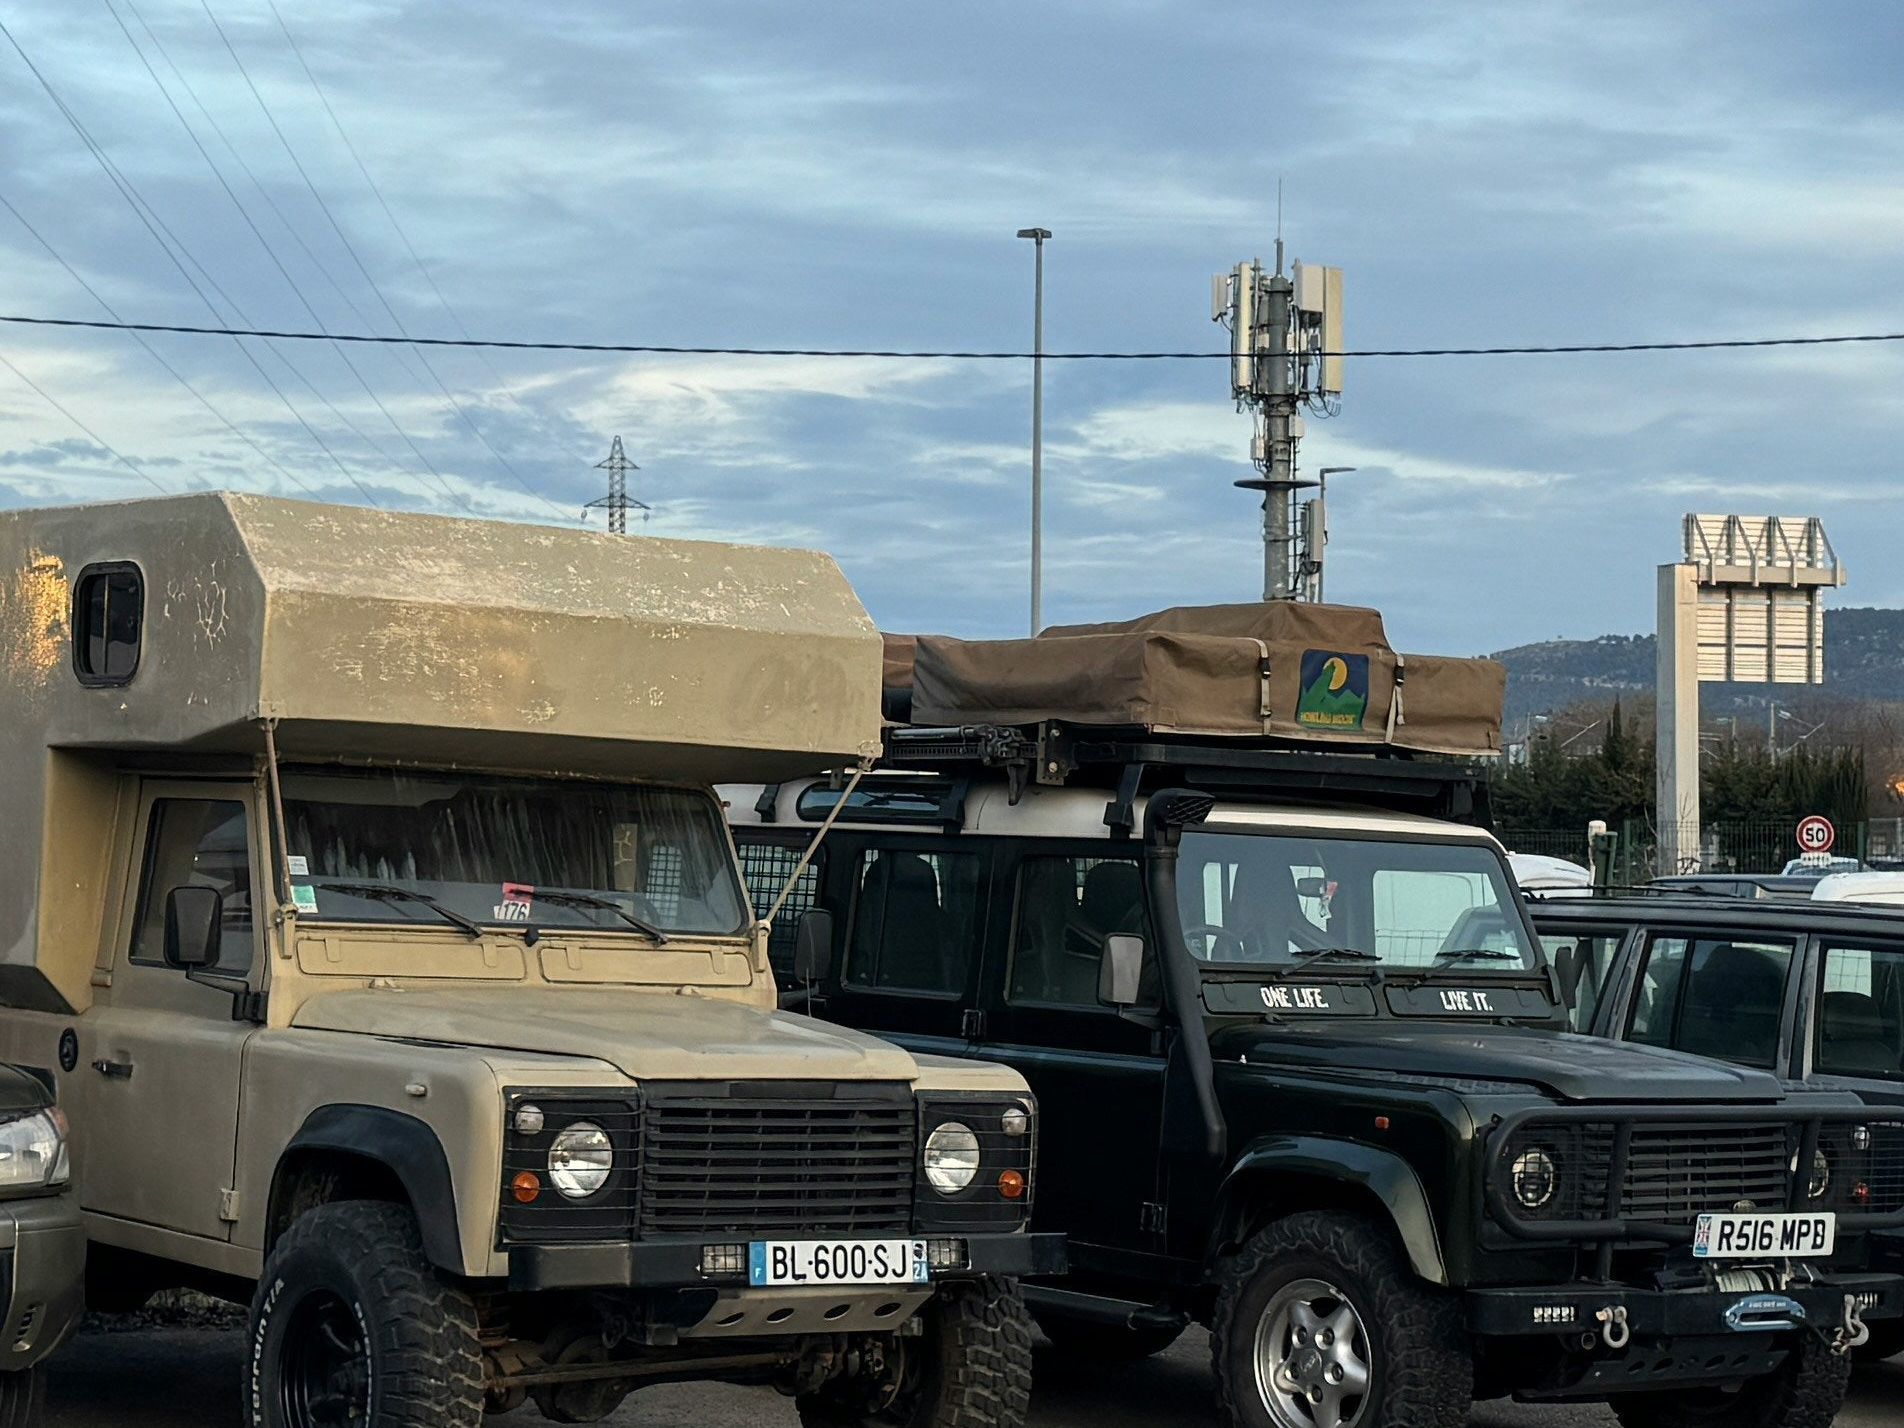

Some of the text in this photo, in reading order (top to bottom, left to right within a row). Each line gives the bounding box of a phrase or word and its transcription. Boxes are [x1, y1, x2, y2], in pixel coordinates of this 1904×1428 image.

[1805, 827, 1825, 842] 50
[1260, 987, 1329, 1009] ONE LIFE.
[1440, 991, 1494, 1012] LIVE IT.
[1717, 1220, 1775, 1251] R516
[913, 1263, 928, 1280] 2A
[263, 1278, 285, 1314] T/A
